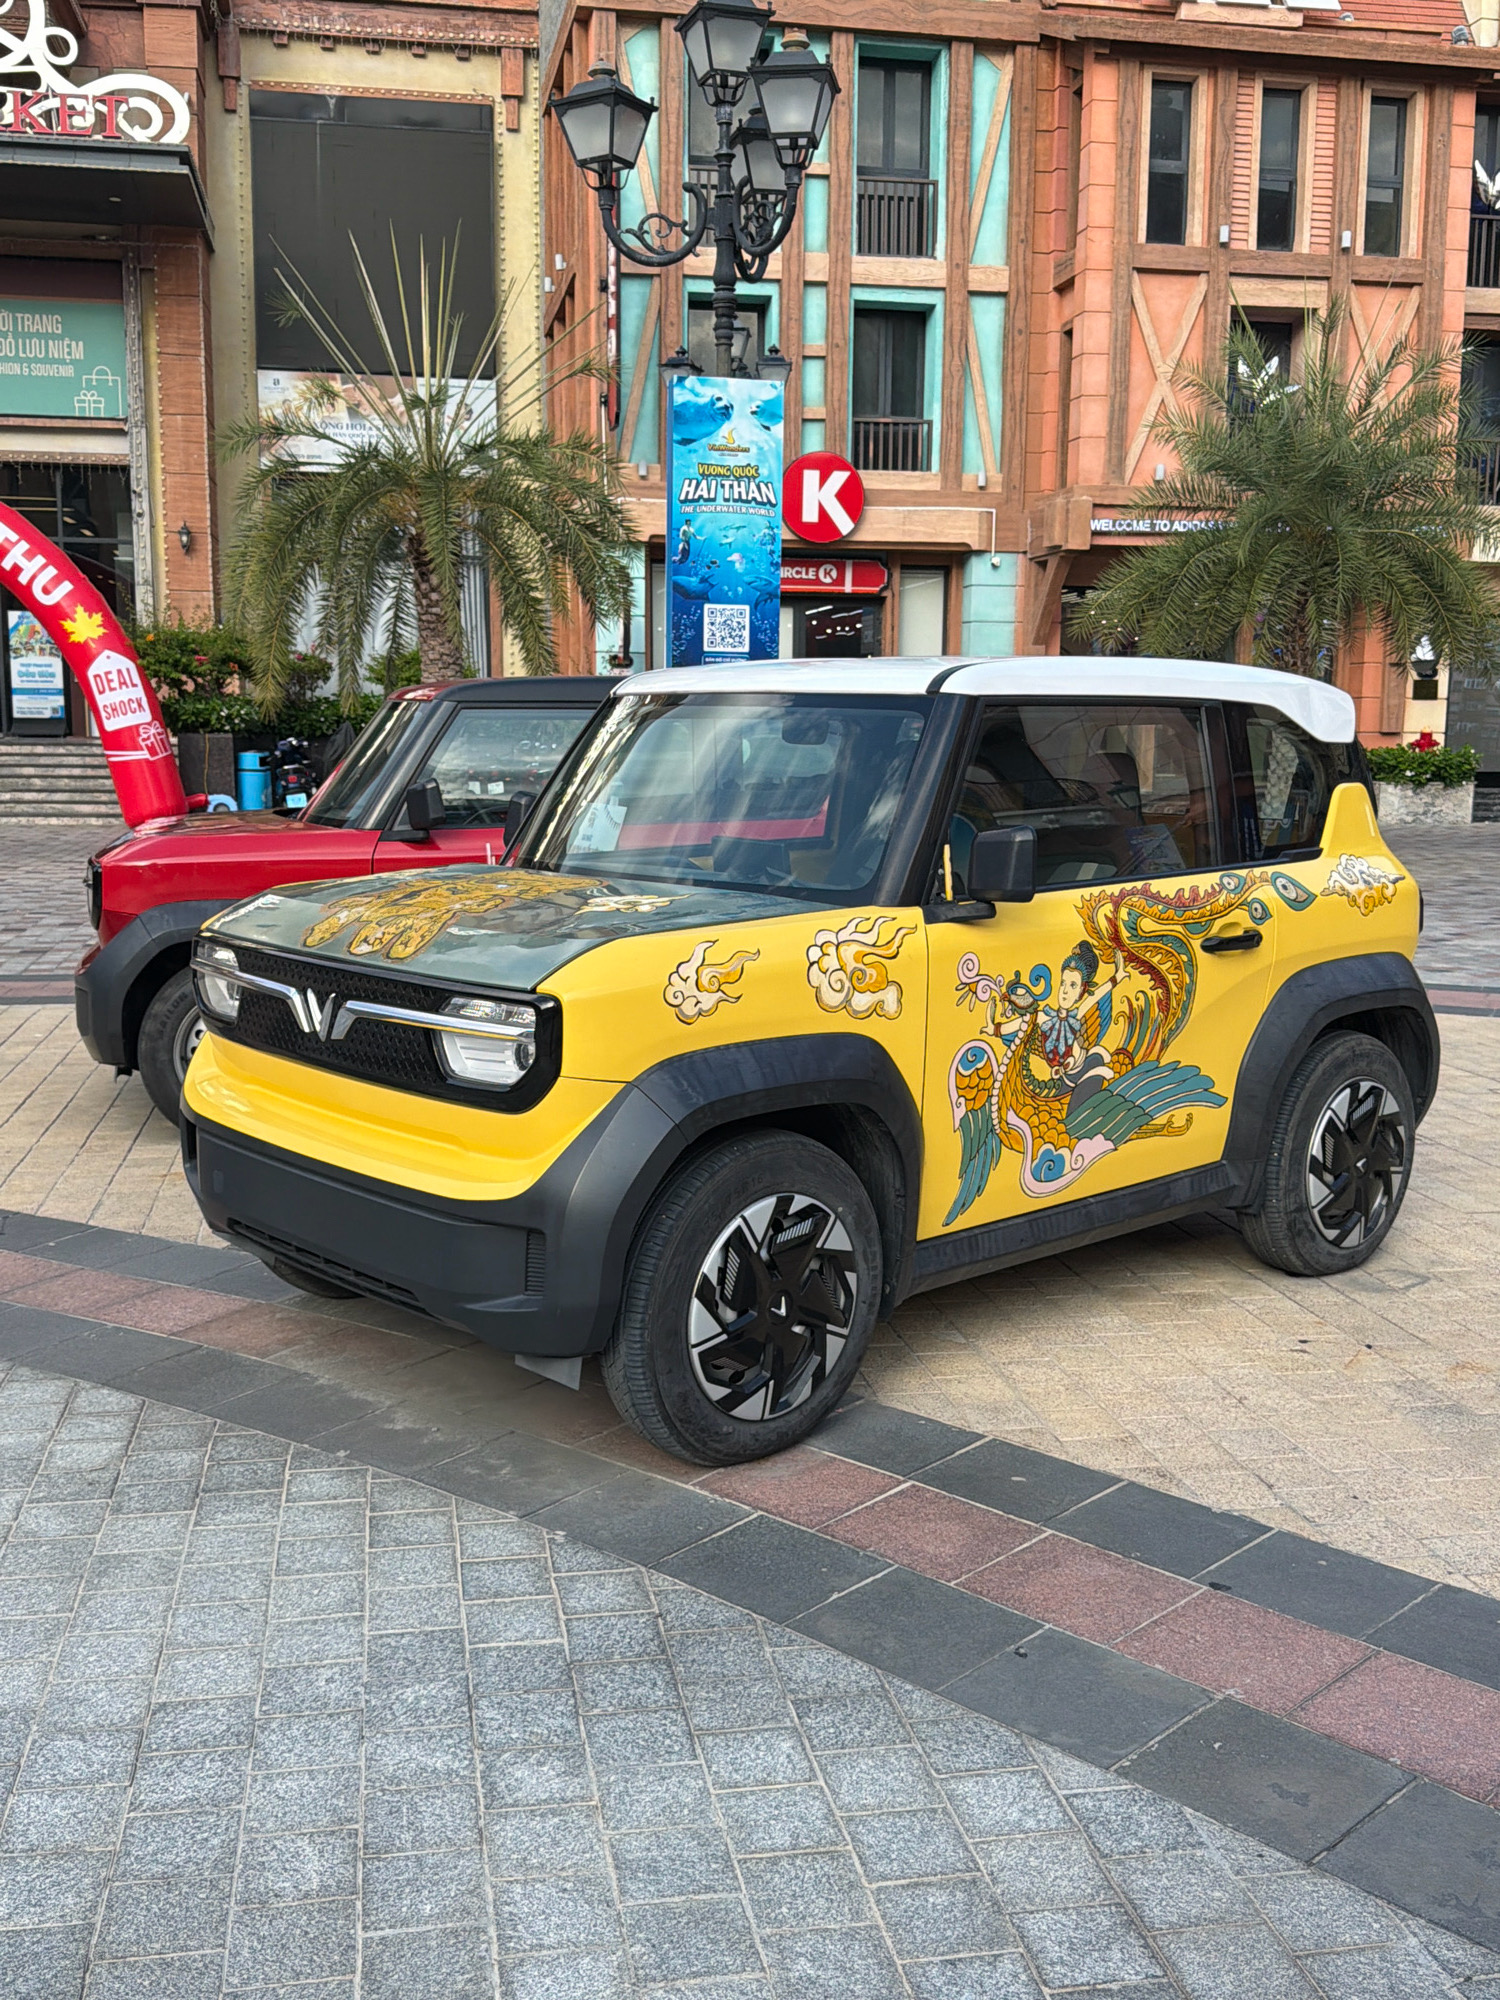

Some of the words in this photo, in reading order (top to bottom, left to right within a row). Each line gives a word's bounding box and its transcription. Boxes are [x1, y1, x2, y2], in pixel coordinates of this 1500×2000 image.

[0, 90, 131, 138] KET
[16, 313, 62, 334] TRANG
[48, 337, 84, 363] NIỆM
[22, 362, 29, 376] &
[31, 363, 75, 377] SOUVENIR
[681, 505, 694, 513] THE
[696, 505, 746, 514] UNDERWATER
[748, 507, 776, 517] WORLD
[801, 469, 856, 537] K
[1090, 519, 1151, 531] WELCOME
[1153, 520, 1170, 531] TO
[93, 667, 139, 695] DEAL
[102, 696, 146, 721] SHOCK
